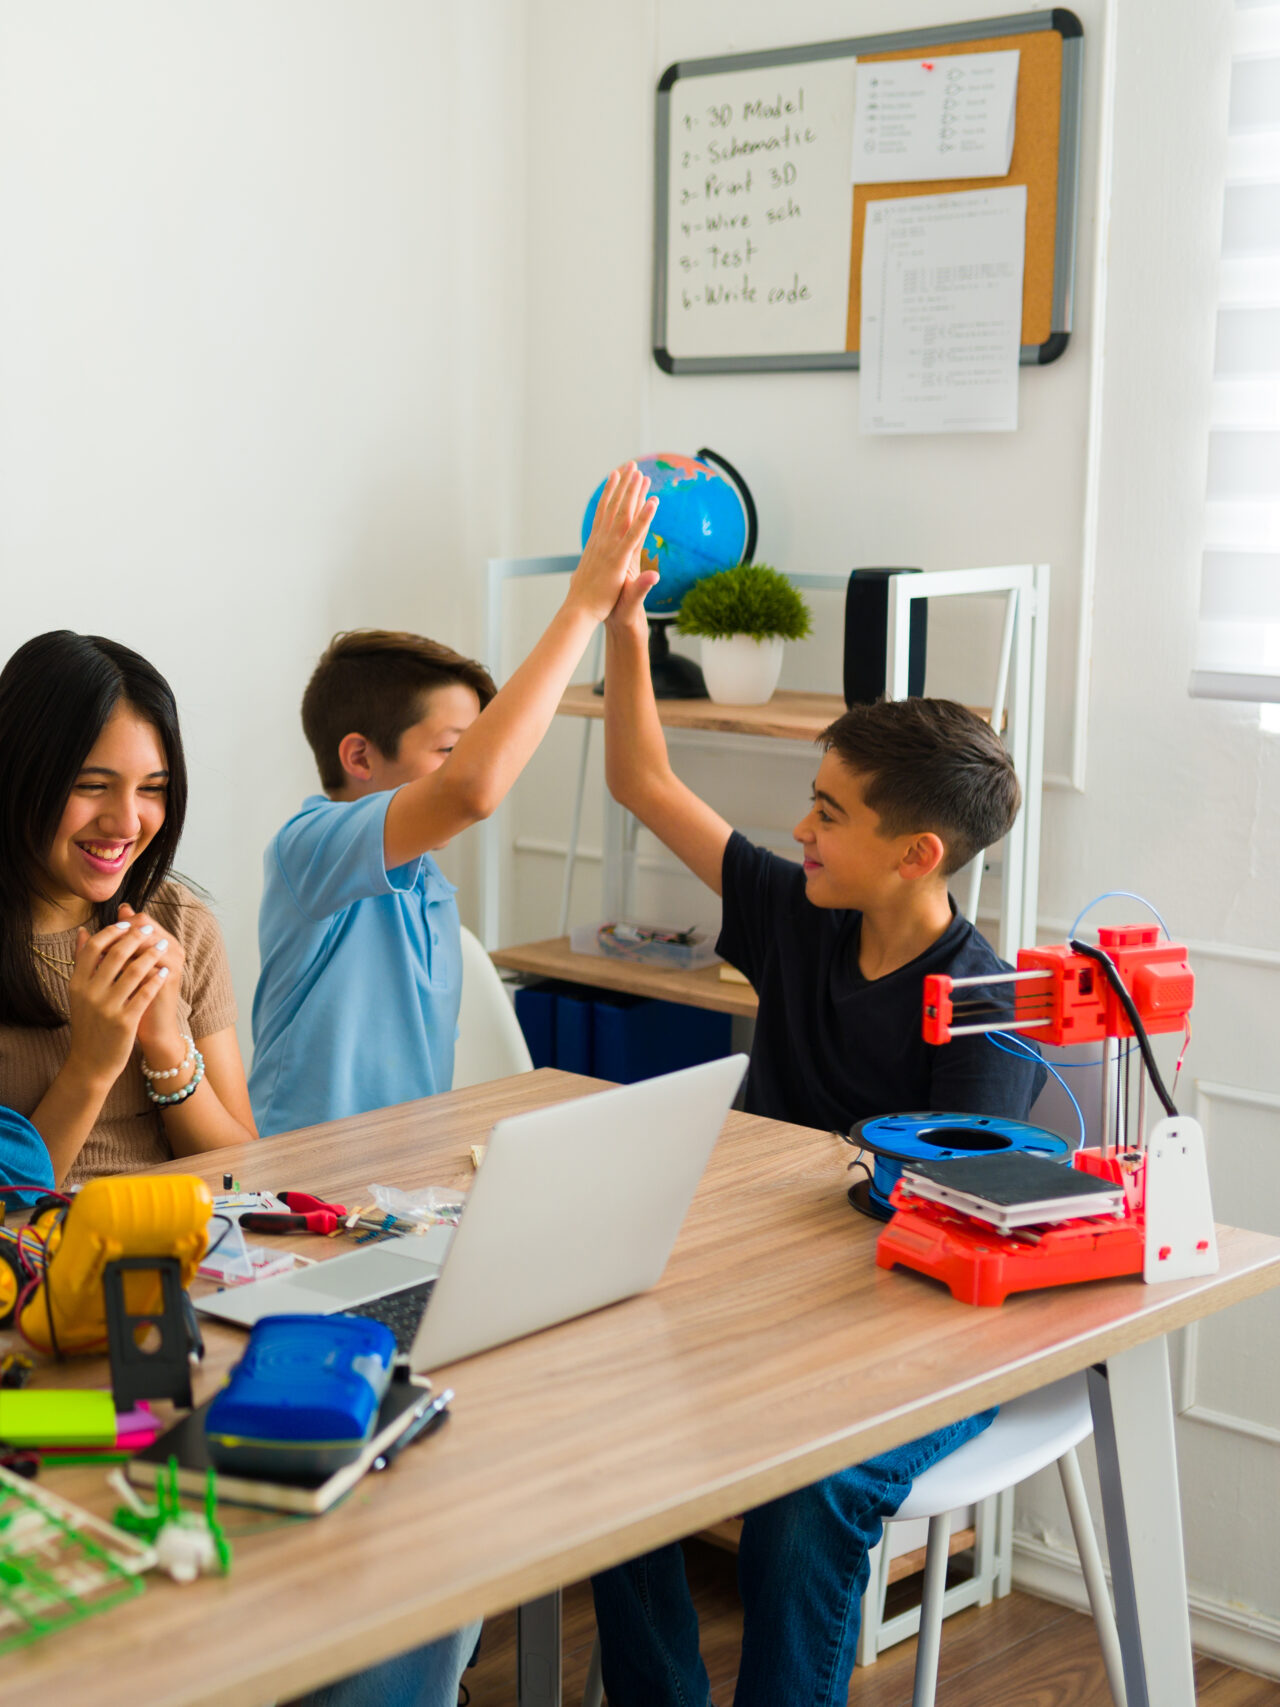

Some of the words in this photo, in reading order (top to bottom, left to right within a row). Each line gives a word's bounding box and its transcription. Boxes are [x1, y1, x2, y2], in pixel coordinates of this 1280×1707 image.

[707, 103, 733, 128] 3D
[743, 87, 805, 121] Model
[707, 124, 817, 164] Schematic
[705, 168, 753, 200] Print
[769, 161, 798, 188] 3D
[707, 237, 760, 270] Test
[767, 272, 813, 305] code
